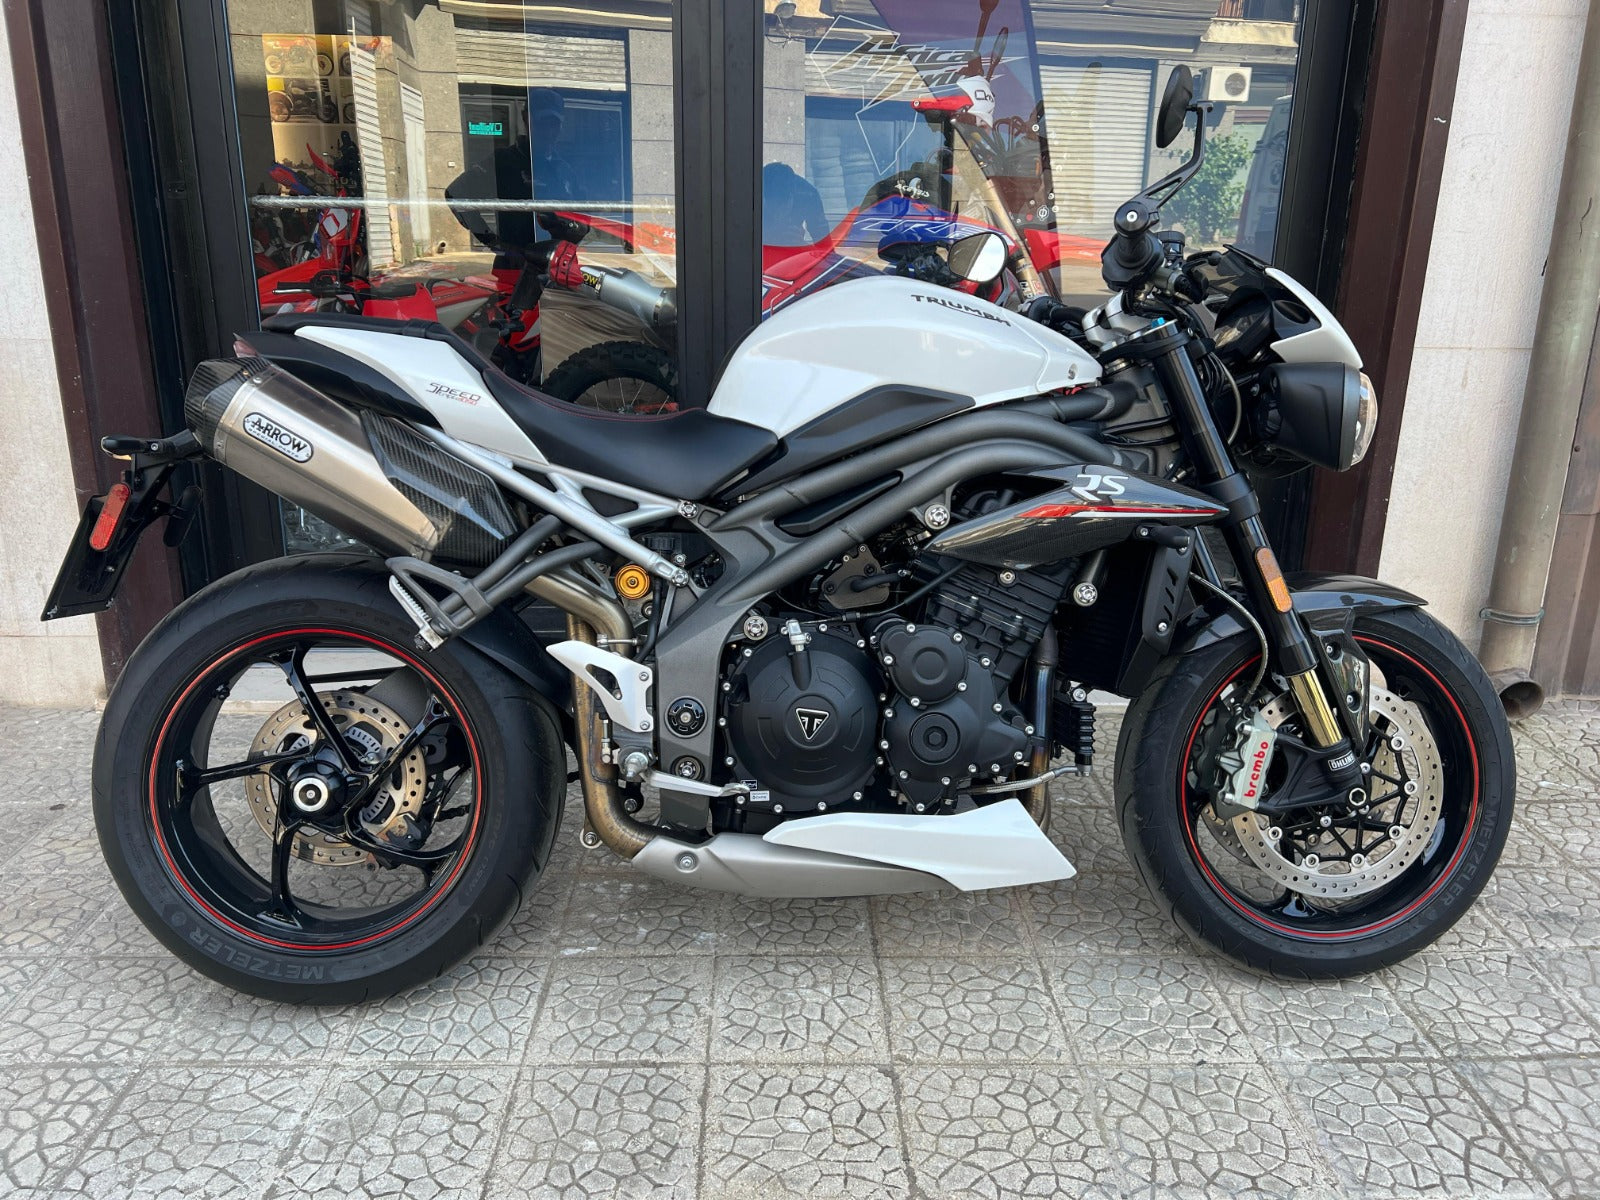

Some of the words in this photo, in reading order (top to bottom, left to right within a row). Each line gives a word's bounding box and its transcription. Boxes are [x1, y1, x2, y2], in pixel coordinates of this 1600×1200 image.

[910, 294, 1012, 328] TRIUMPH
[426, 382, 481, 402] SPEED
[245, 417, 308, 453] ARROW
[1071, 474, 1129, 501] RS
[1243, 741, 1269, 798] brembo
[1443, 808, 1498, 907] METZELER
[188, 926, 325, 981] METZELER
